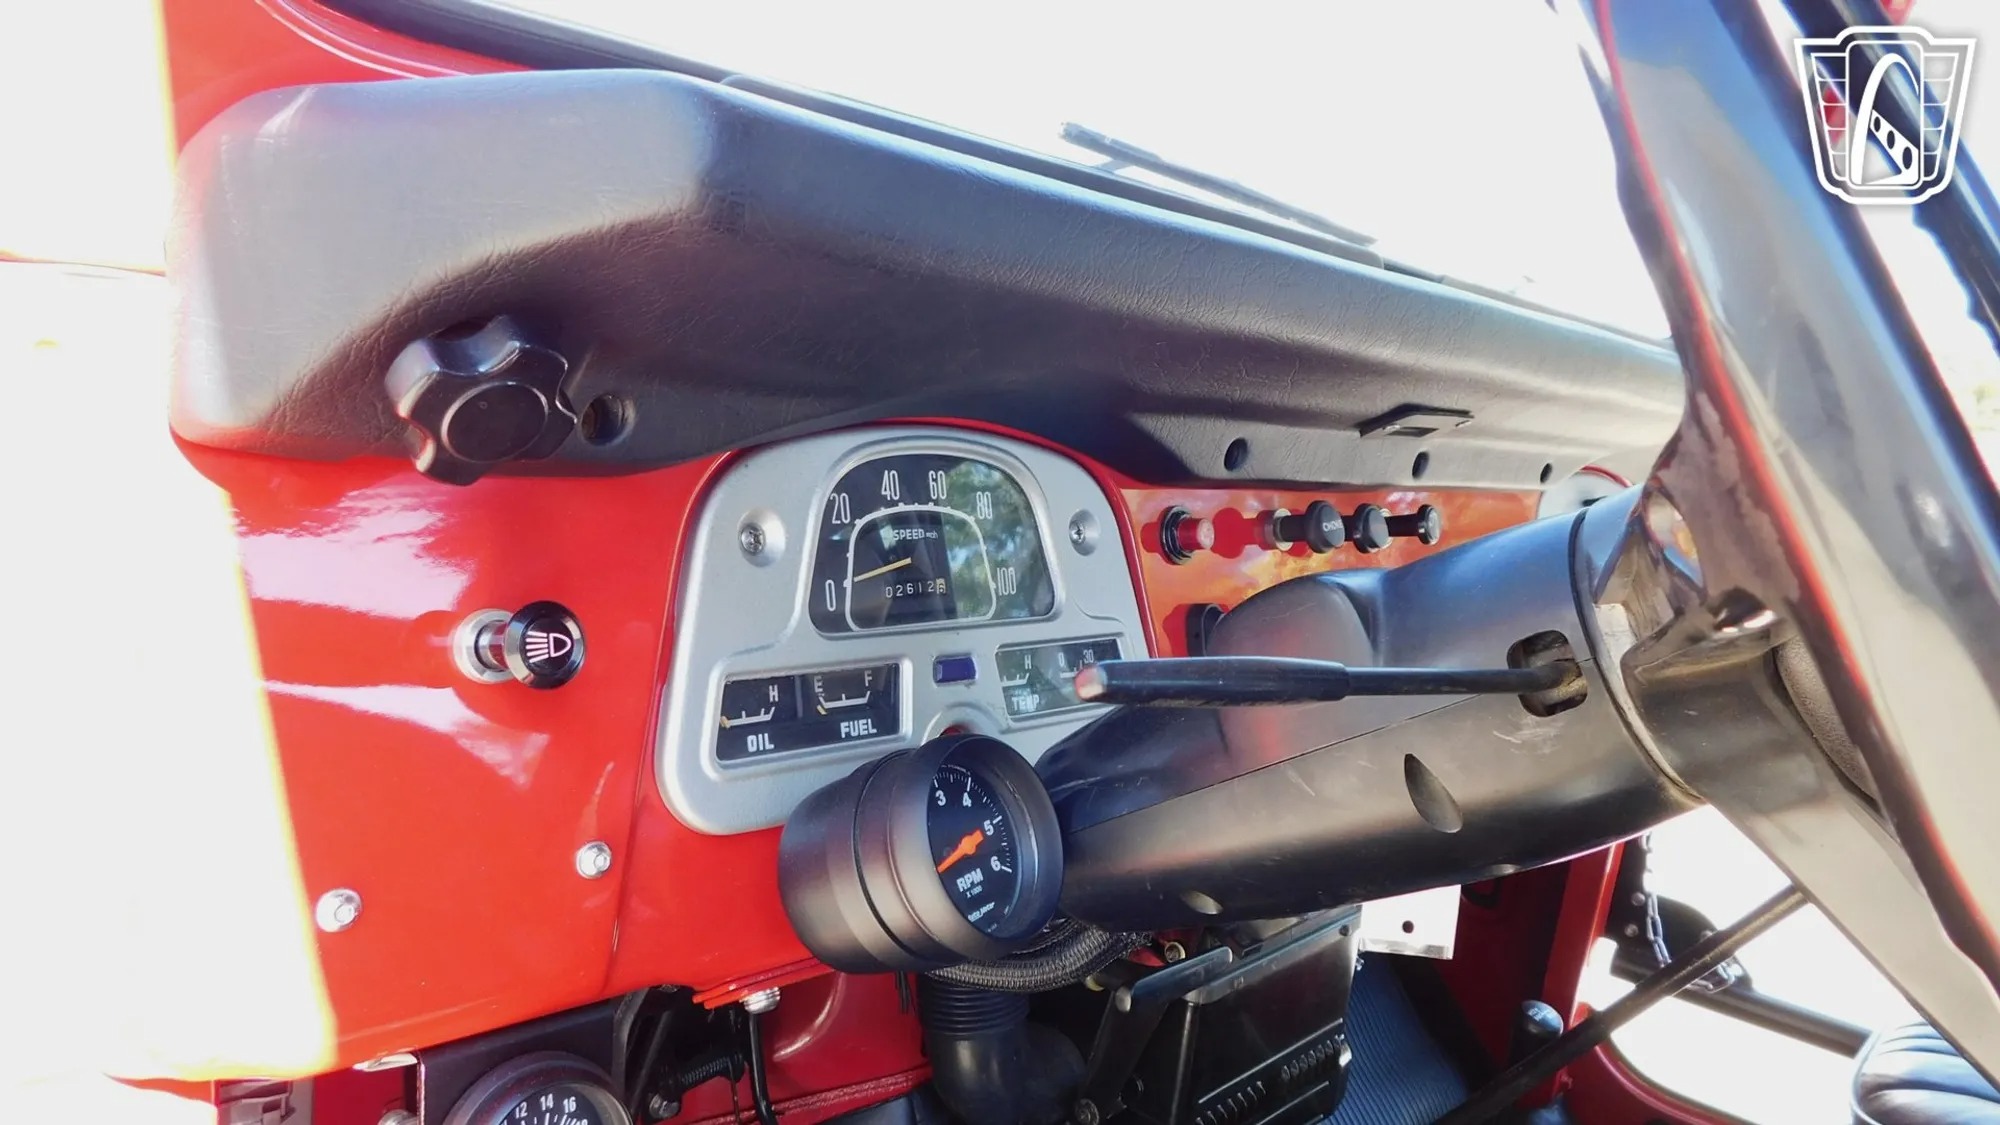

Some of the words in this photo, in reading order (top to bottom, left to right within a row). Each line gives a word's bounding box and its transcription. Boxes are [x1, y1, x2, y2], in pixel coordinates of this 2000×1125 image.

[882, 470, 900, 501] 40
[929, 470, 946, 499] 60
[831, 492, 850, 525] 20
[976, 491, 993, 521] 80
[893, 528, 925, 541] SPEED
[996, 567, 1016, 596] 100
[825, 579, 836, 612] 0
[1024, 654, 1032, 670] H
[1083, 649, 1094, 664] 30
[813, 675, 824, 695] E
[864, 670, 873, 687] F
[769, 684, 778, 703] H
[1011, 694, 1040, 712] TEMP
[840, 718, 877, 739] FUEL
[747, 733, 775, 752] OIL
[935, 789, 946, 806] 3
[962, 793, 972, 808] 4
[983, 819, 994, 836] 5
[990, 855, 1001, 872] 6
[956, 868, 984, 892] RPM
[515, 1101, 528, 1119] 12
[540, 1093, 554, 1111] 14
[563, 1096, 577, 1113] 16
